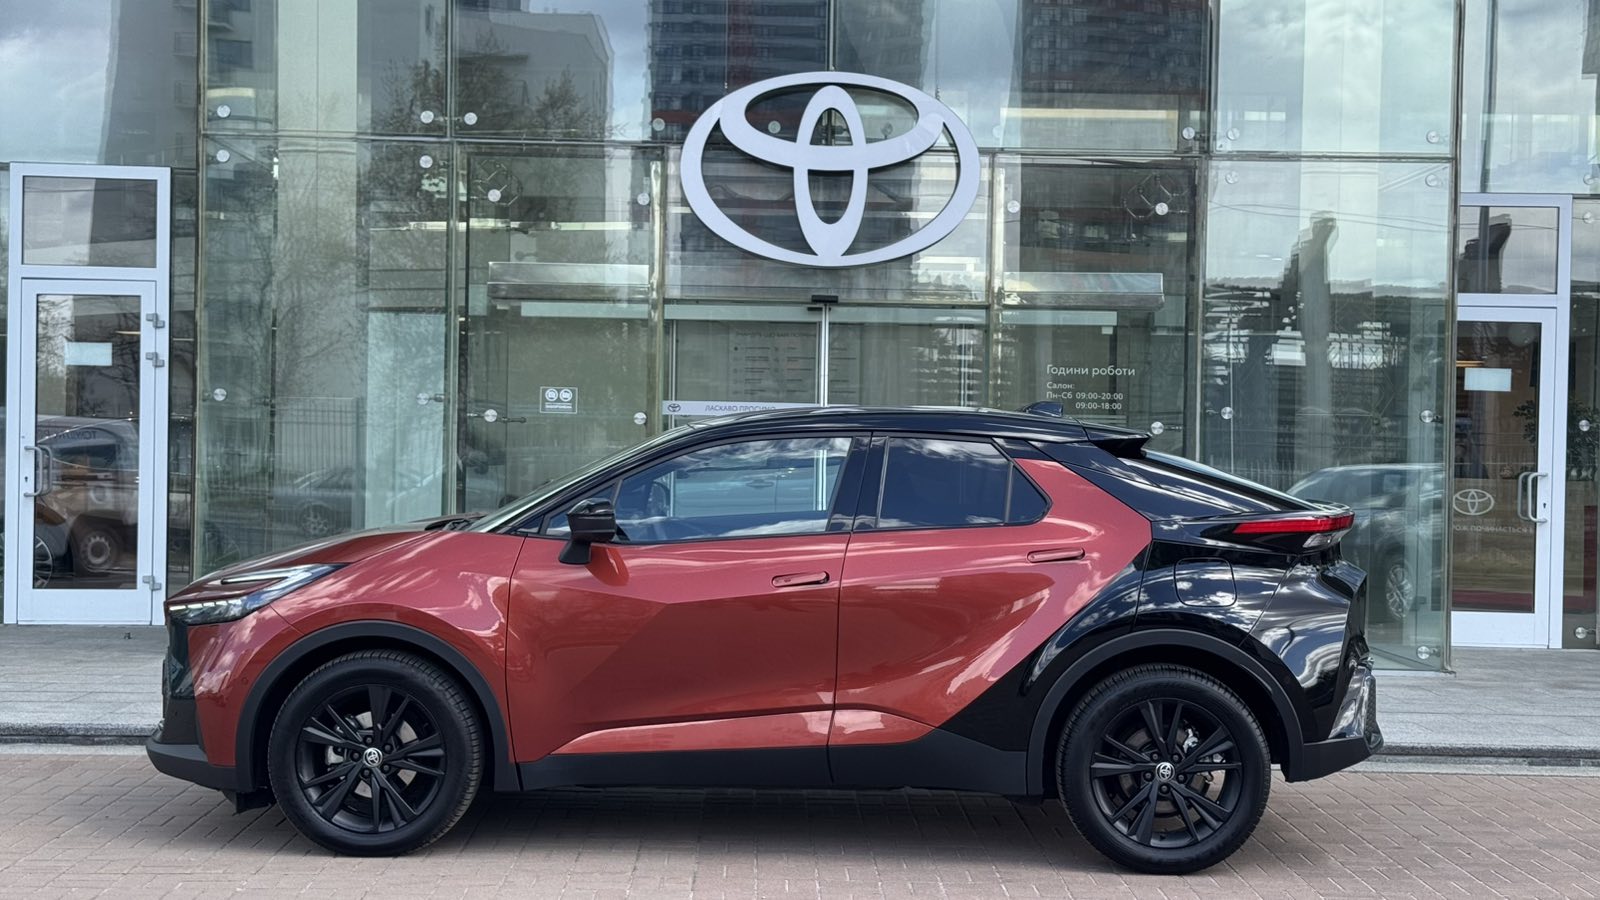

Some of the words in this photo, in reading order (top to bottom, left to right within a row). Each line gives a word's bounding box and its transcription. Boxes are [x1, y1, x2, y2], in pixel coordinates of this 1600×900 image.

[1046, 364, 1088, 376] Години
[1092, 365, 1135, 378] роботи
[1046, 381, 1074, 389] Салон:
[1075, 392, 1123, 400] 09:00-20:00
[705, 404, 738, 412] ЛАСКАВО
[1075, 401, 1122, 409] 09:00-18:00
